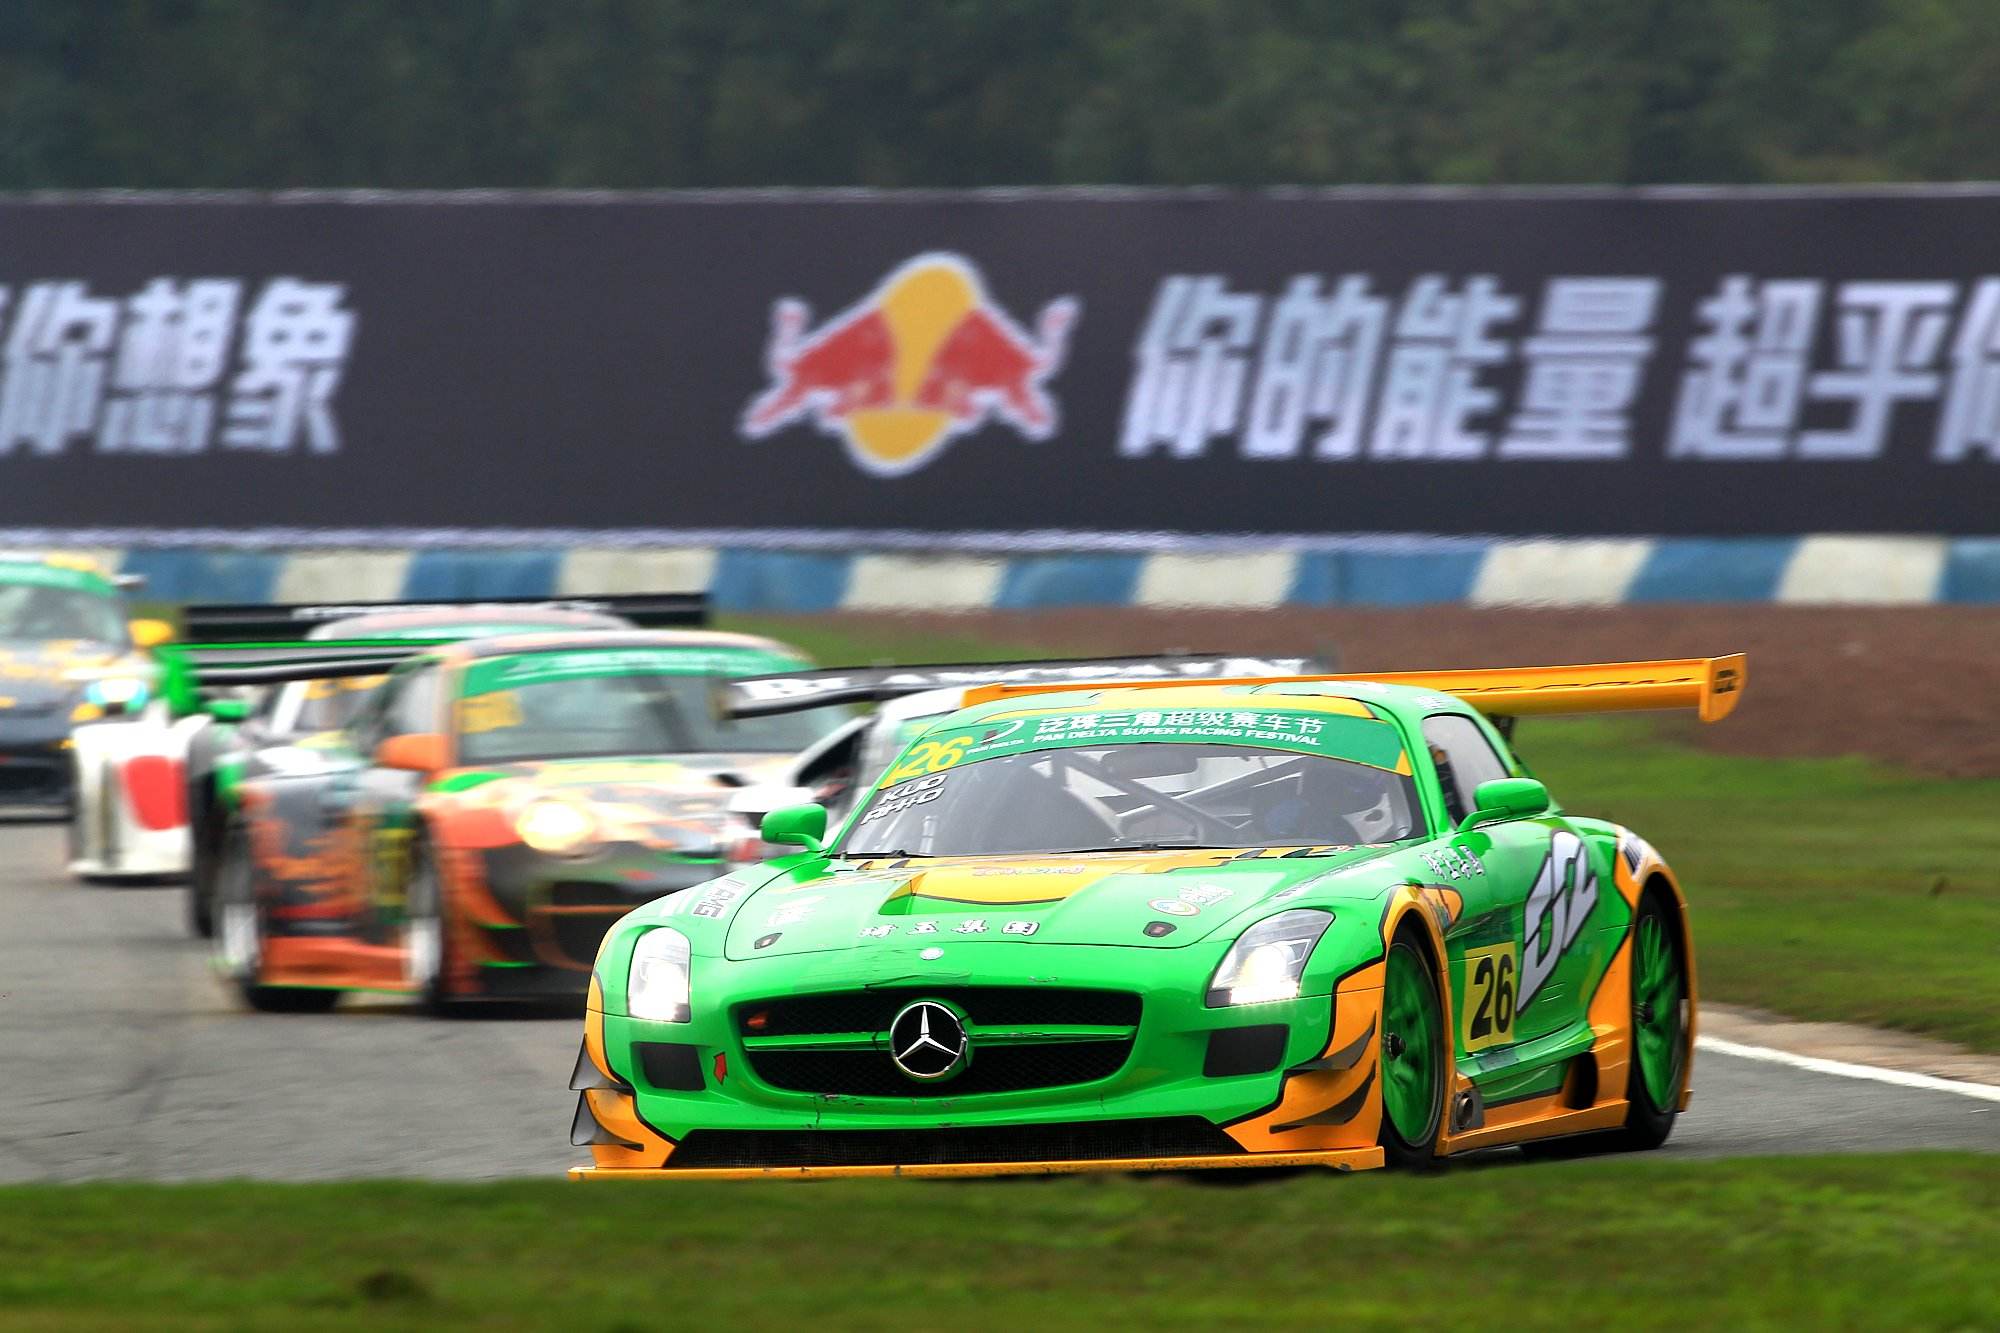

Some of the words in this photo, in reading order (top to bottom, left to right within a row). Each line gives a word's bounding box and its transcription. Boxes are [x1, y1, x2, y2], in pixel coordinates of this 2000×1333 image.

[1032, 733, 1065, 743] PAN
[1068, 728, 1118, 739] DELTA
[1121, 727, 1177, 736] SUPER
[1178, 727, 1242, 737] RACING
[1245, 729, 1321, 746] FESTIVAL
[1036, 711, 1327, 735] 泛珠三角超级赛车节
[898, 736, 974, 777] 26
[1470, 954, 1513, 1040] 26
